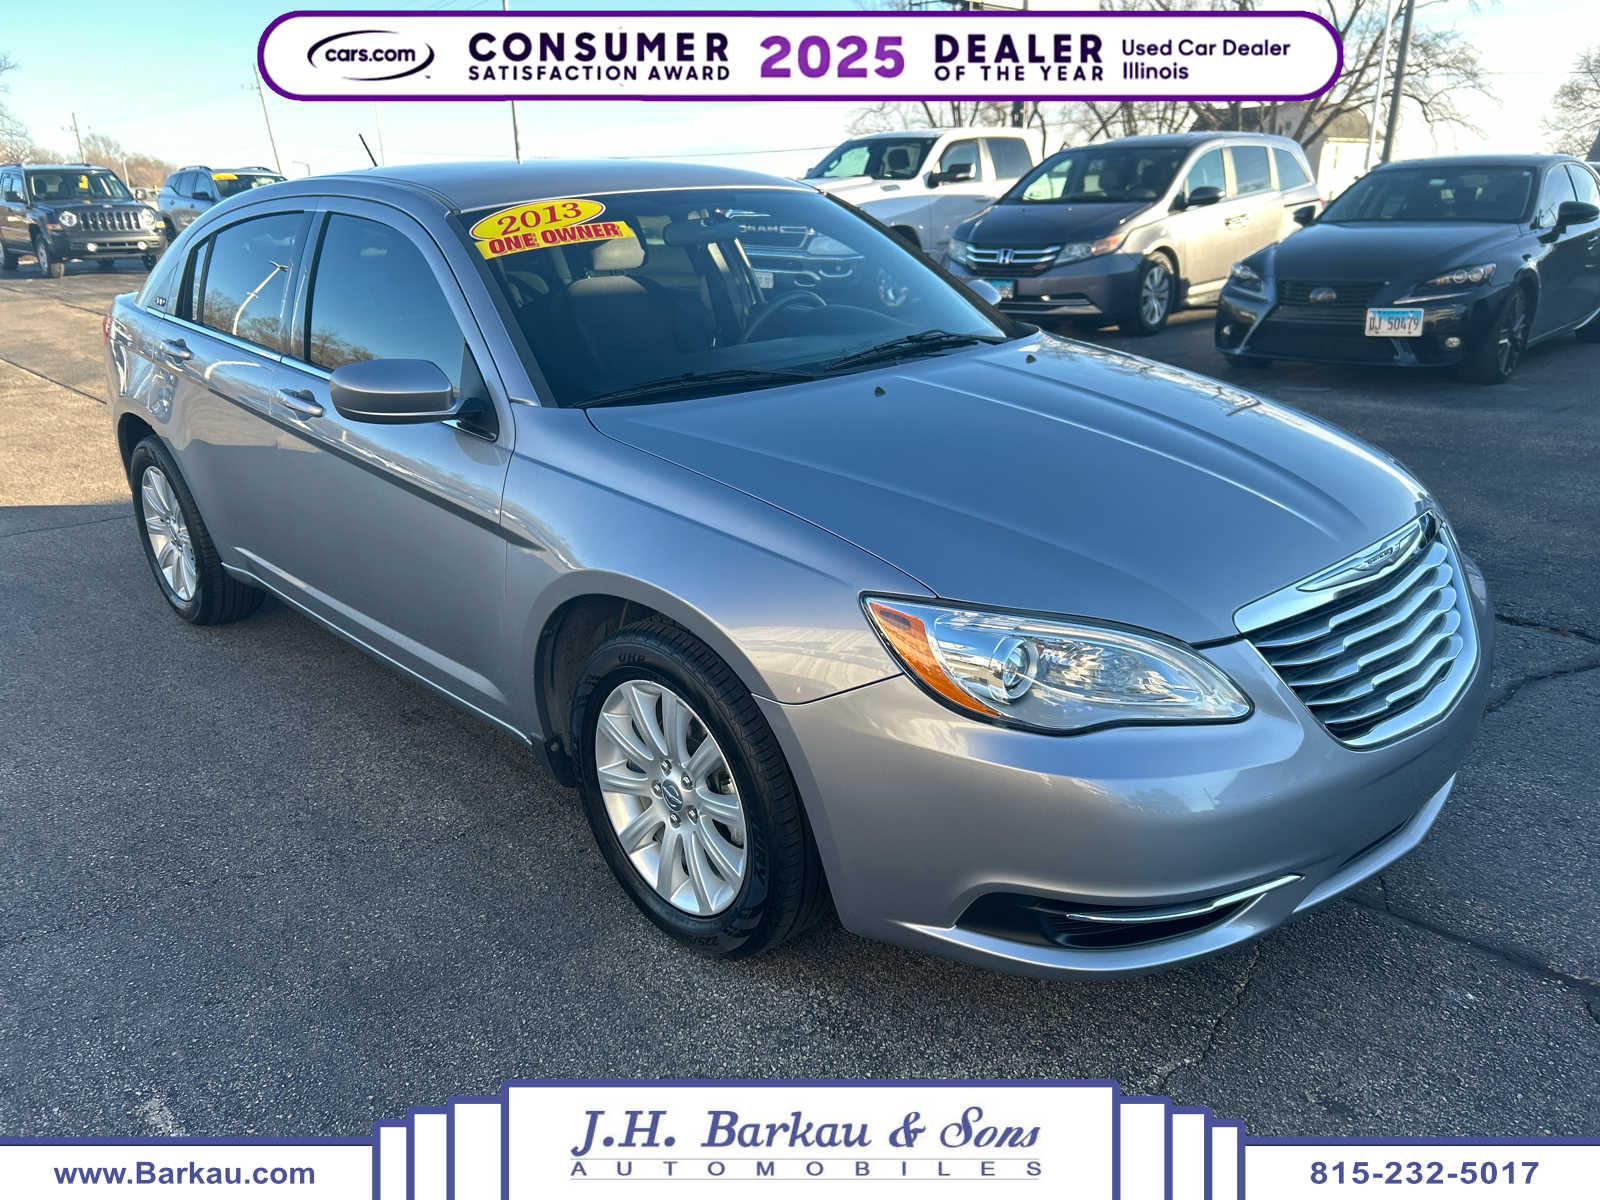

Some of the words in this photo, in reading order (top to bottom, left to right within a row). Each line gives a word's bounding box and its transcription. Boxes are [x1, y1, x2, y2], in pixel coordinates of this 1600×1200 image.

[497, 202, 582, 236] 2013
[488, 232, 539, 255] ONE
[541, 222, 623, 244] OWNER
